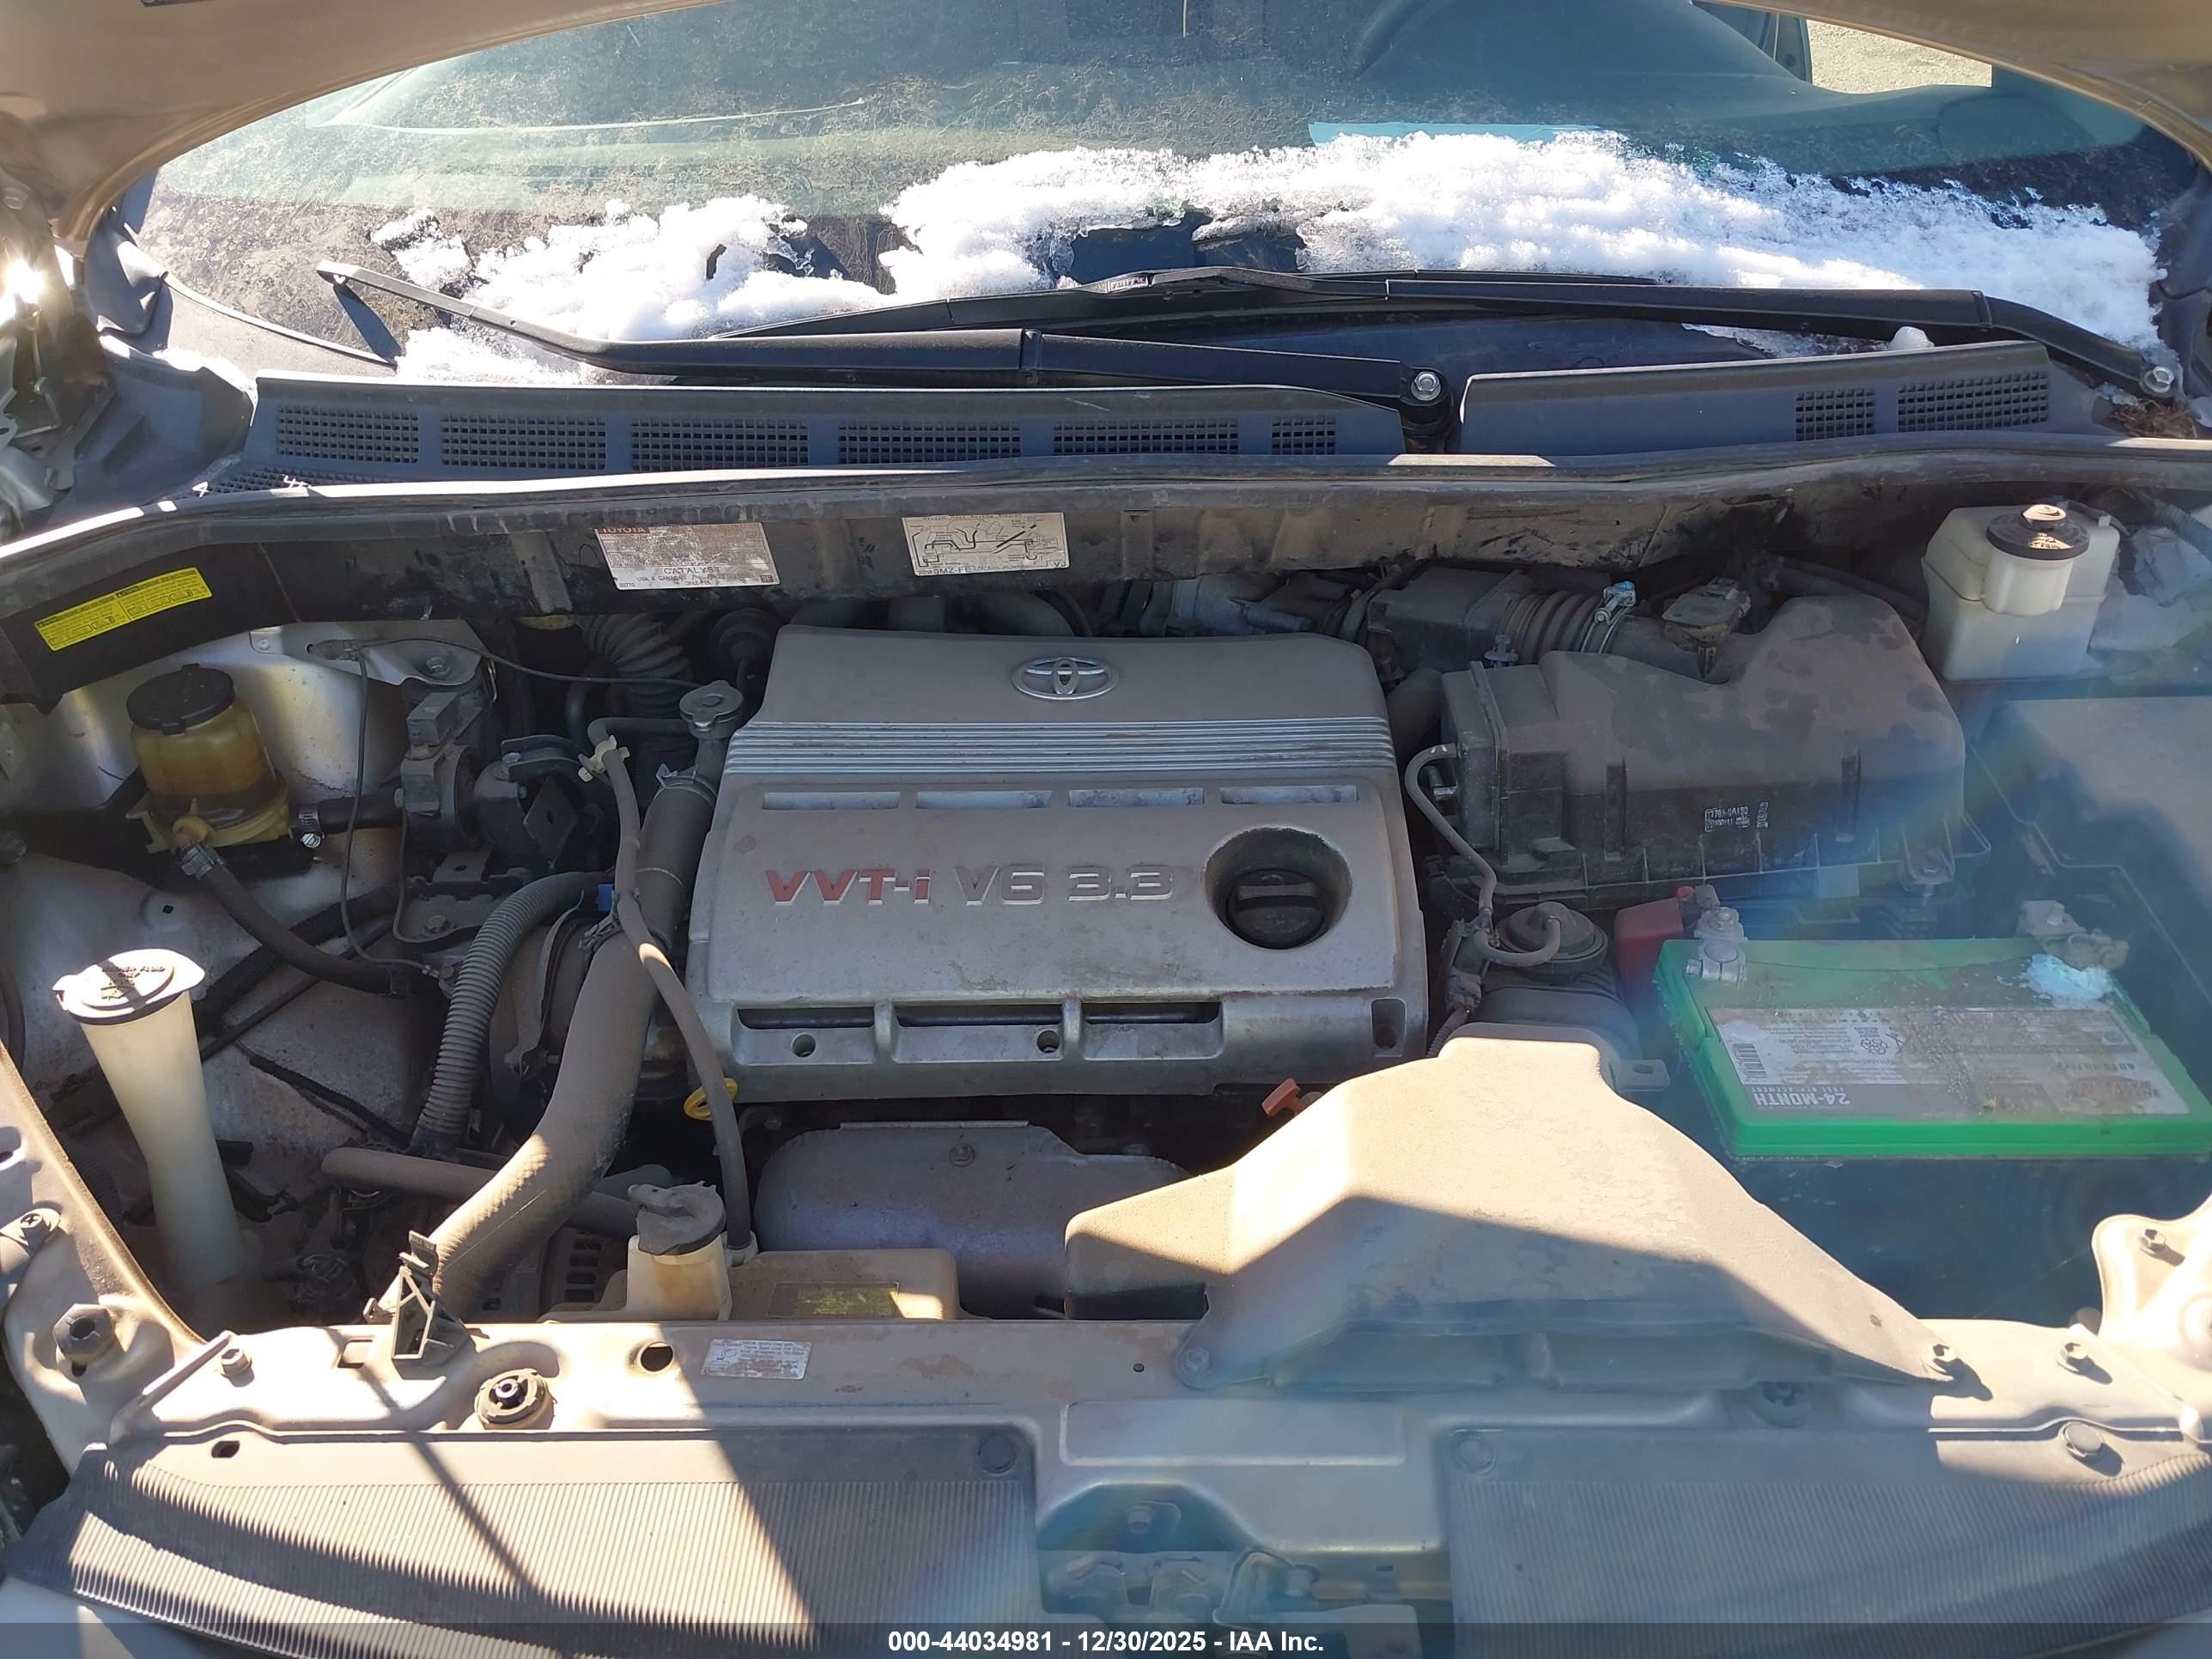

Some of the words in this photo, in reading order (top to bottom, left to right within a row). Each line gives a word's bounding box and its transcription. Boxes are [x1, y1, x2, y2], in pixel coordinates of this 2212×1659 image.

[663, 566, 721, 574] CATALYST
[765, 866, 933, 906] VVT-i
[953, 864, 1045, 906] V6
[1066, 865, 1175, 902] 3.3
[1753, 1092, 1850, 1106] 24-MONTH
